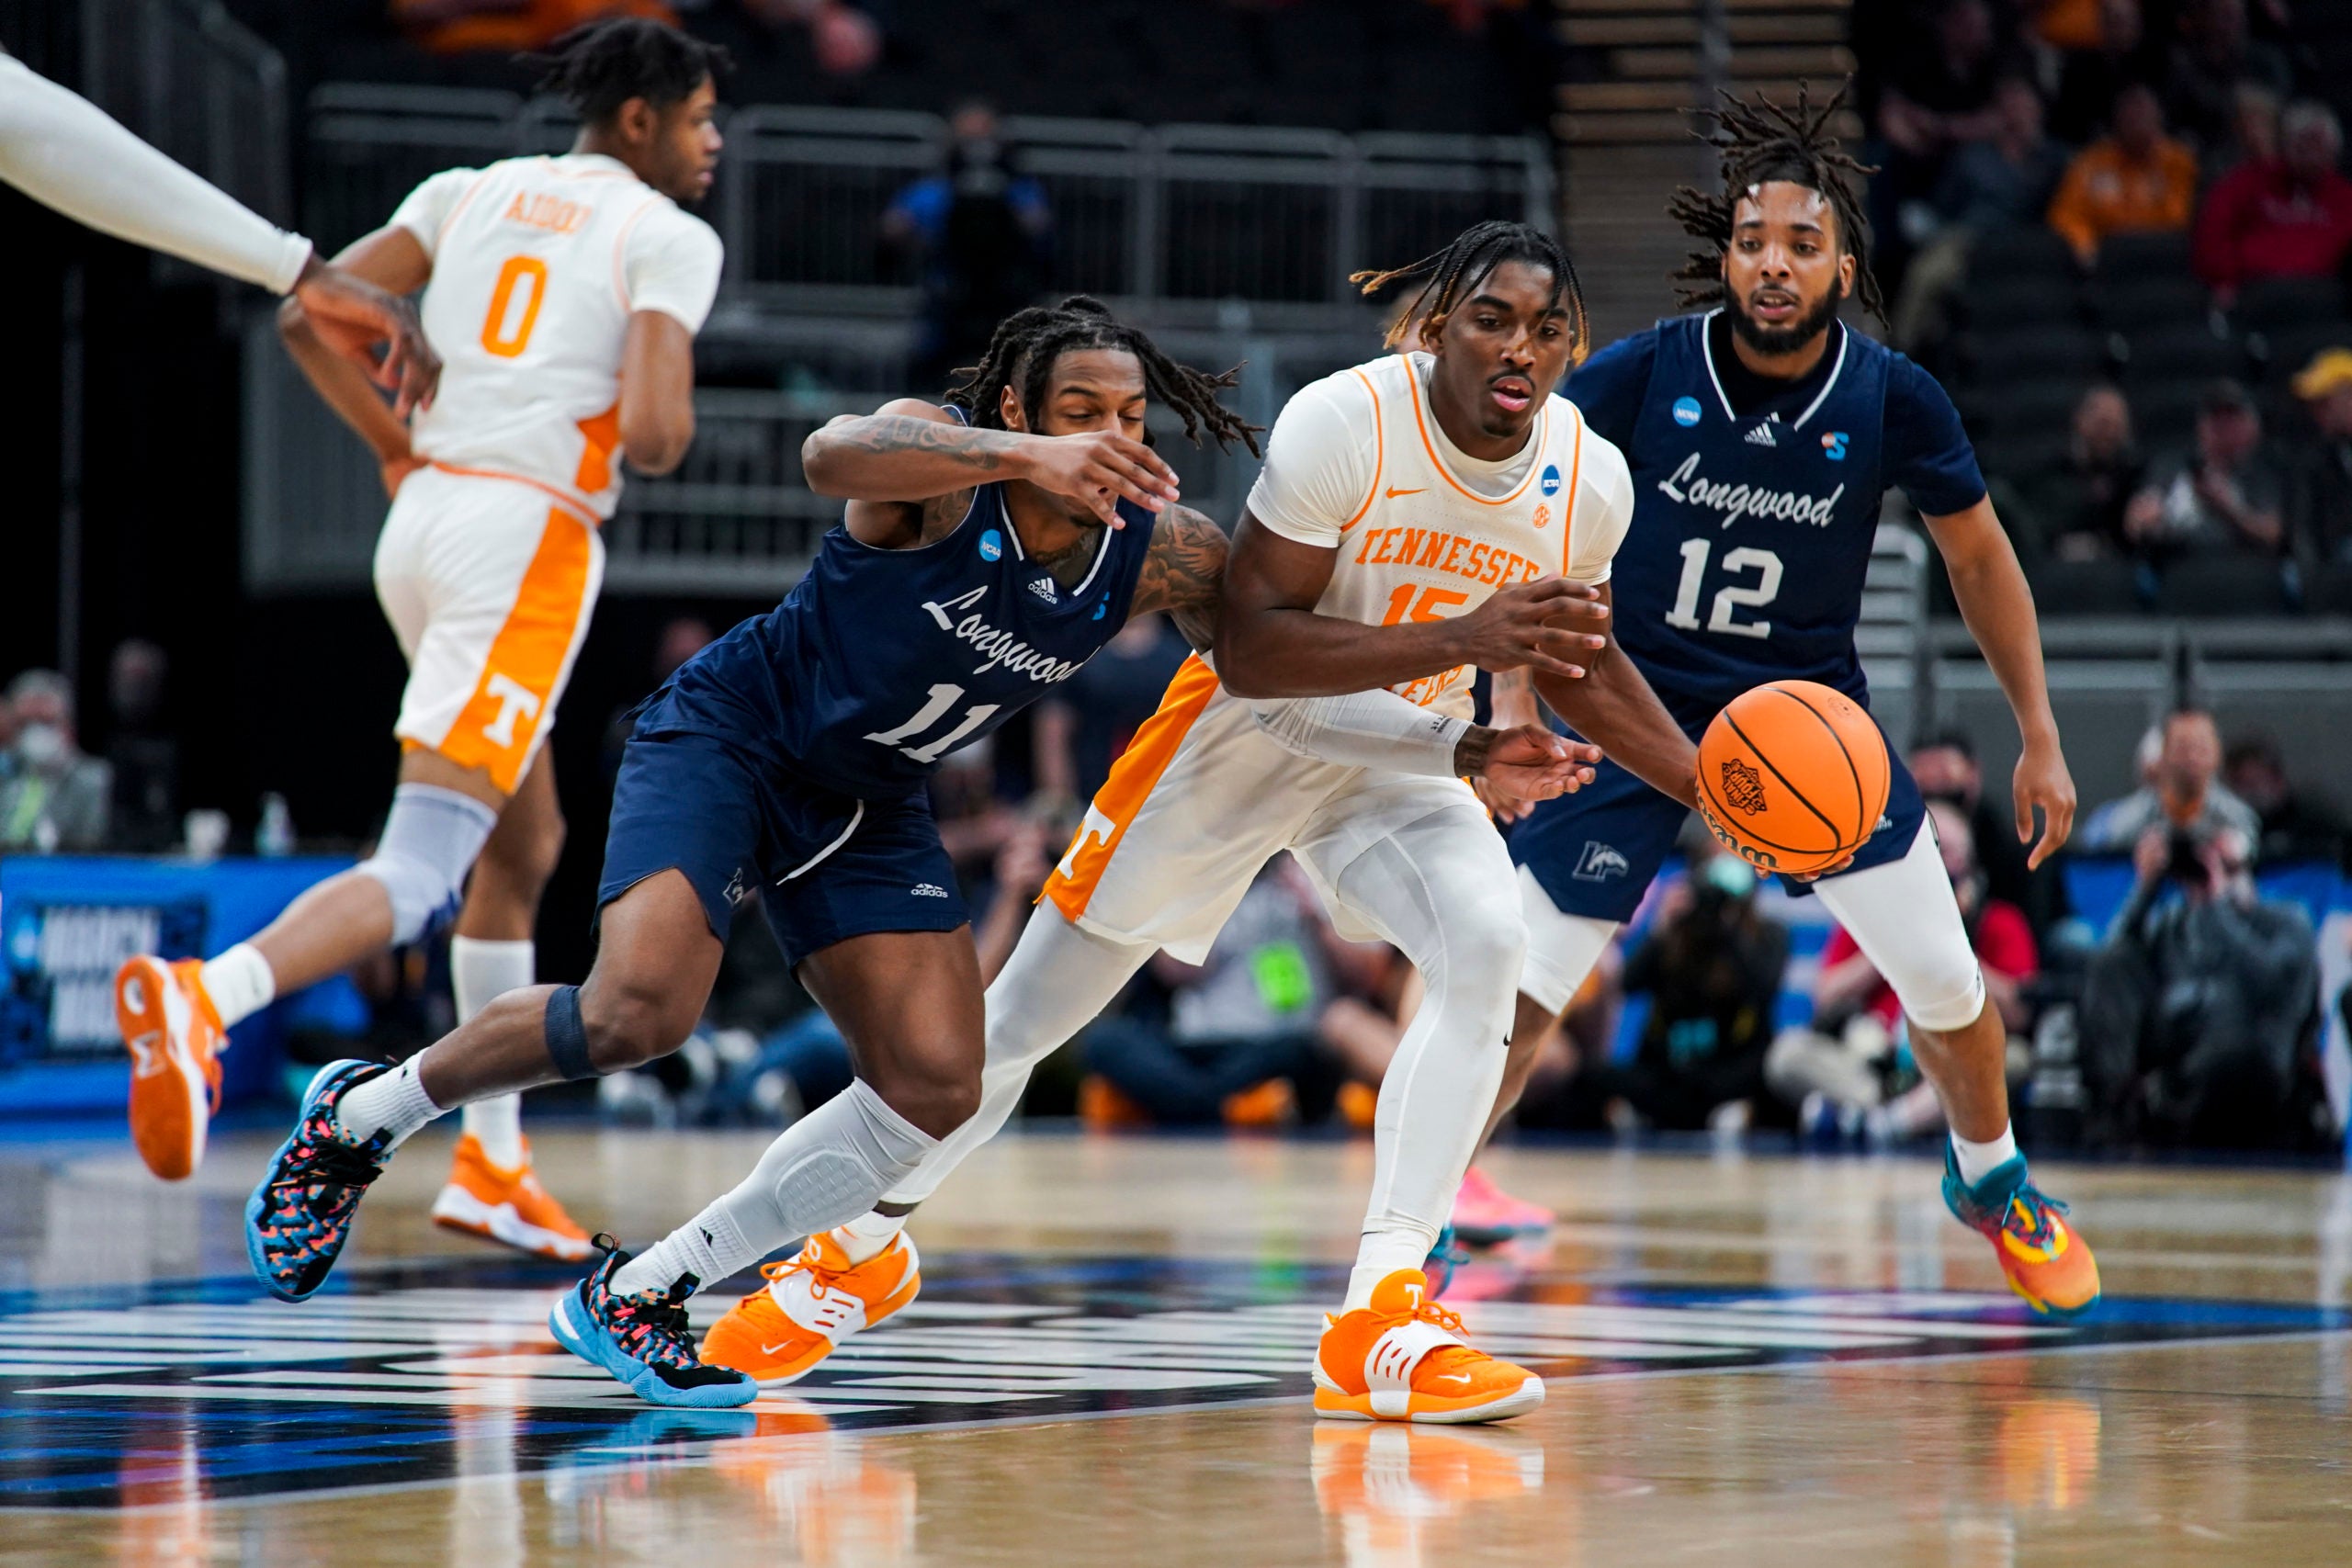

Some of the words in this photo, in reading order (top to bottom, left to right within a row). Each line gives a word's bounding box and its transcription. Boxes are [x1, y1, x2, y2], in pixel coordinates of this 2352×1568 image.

[481, 254, 548, 359] 0
[1657, 451, 1845, 530] Longwood
[1028, 581, 1058, 605] adidas
[1665, 537, 1783, 639] 12
[862, 683, 1002, 764] 11
[910, 887, 948, 898] adidas
